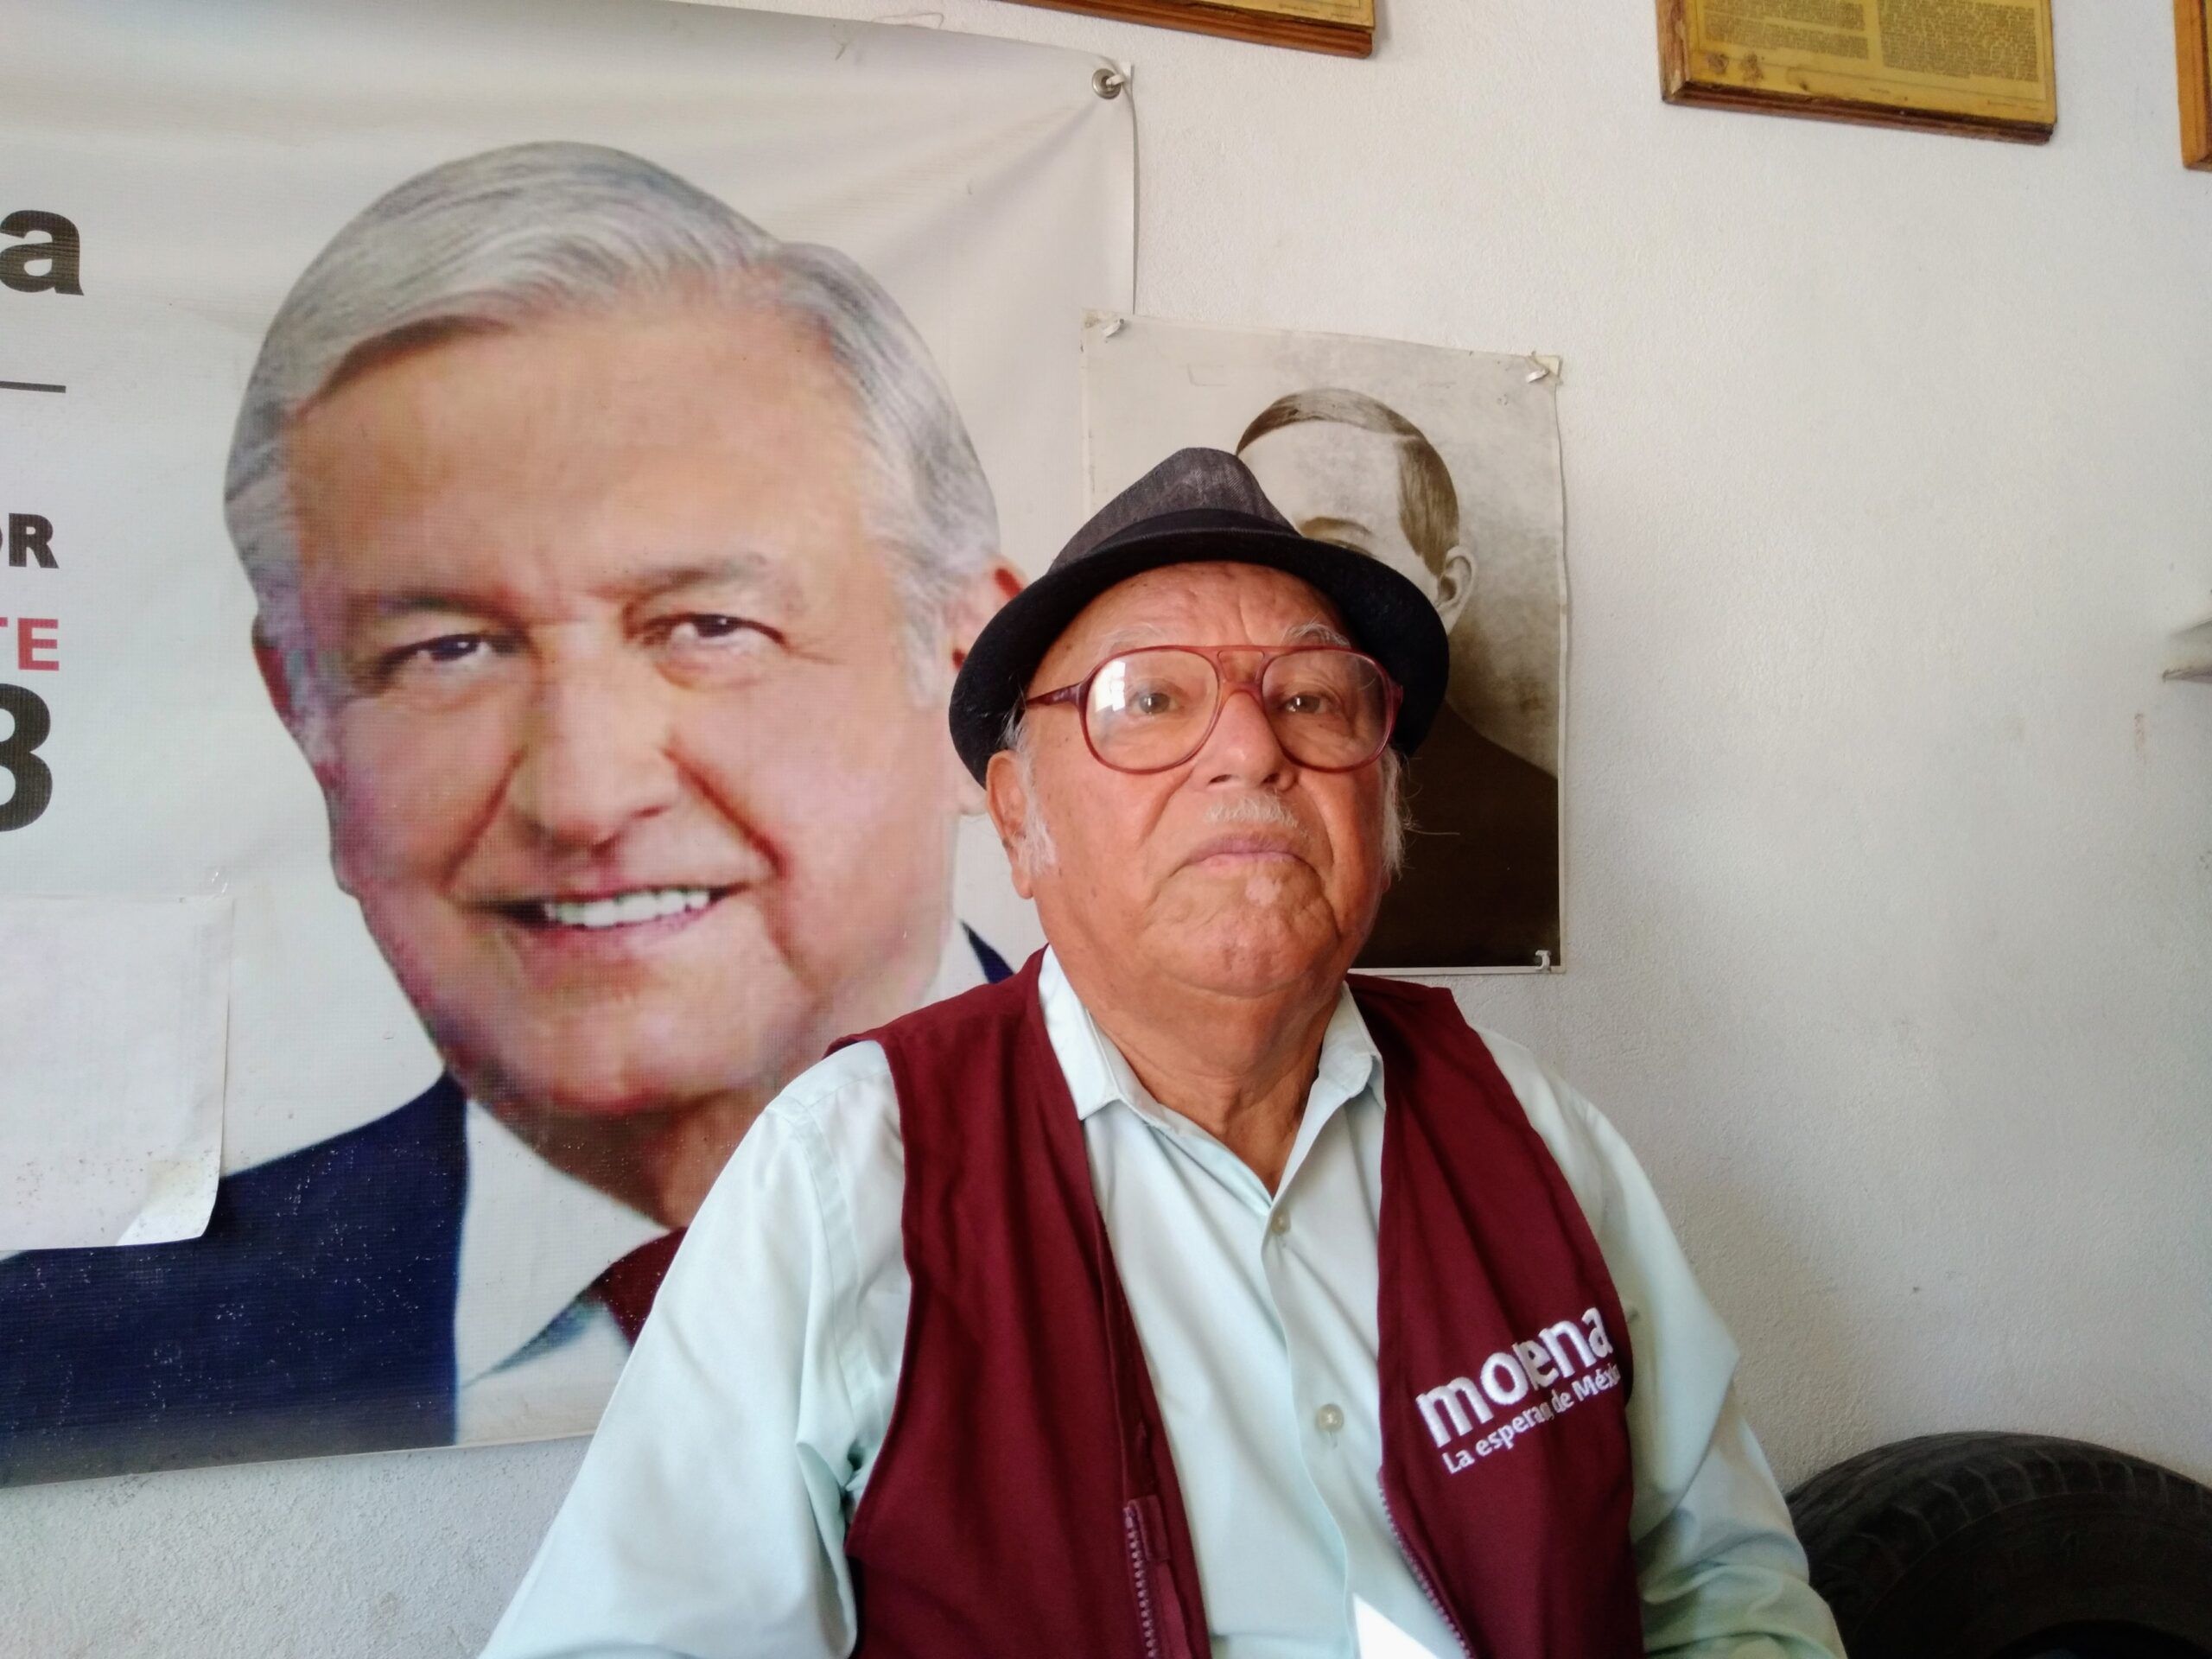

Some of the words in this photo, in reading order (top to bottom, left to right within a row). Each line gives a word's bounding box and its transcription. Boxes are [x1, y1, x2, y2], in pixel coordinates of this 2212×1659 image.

[0, 512, 60, 569] R
[1442, 1450, 1475, 1474] La
[1551, 1389, 1574, 1413] de
